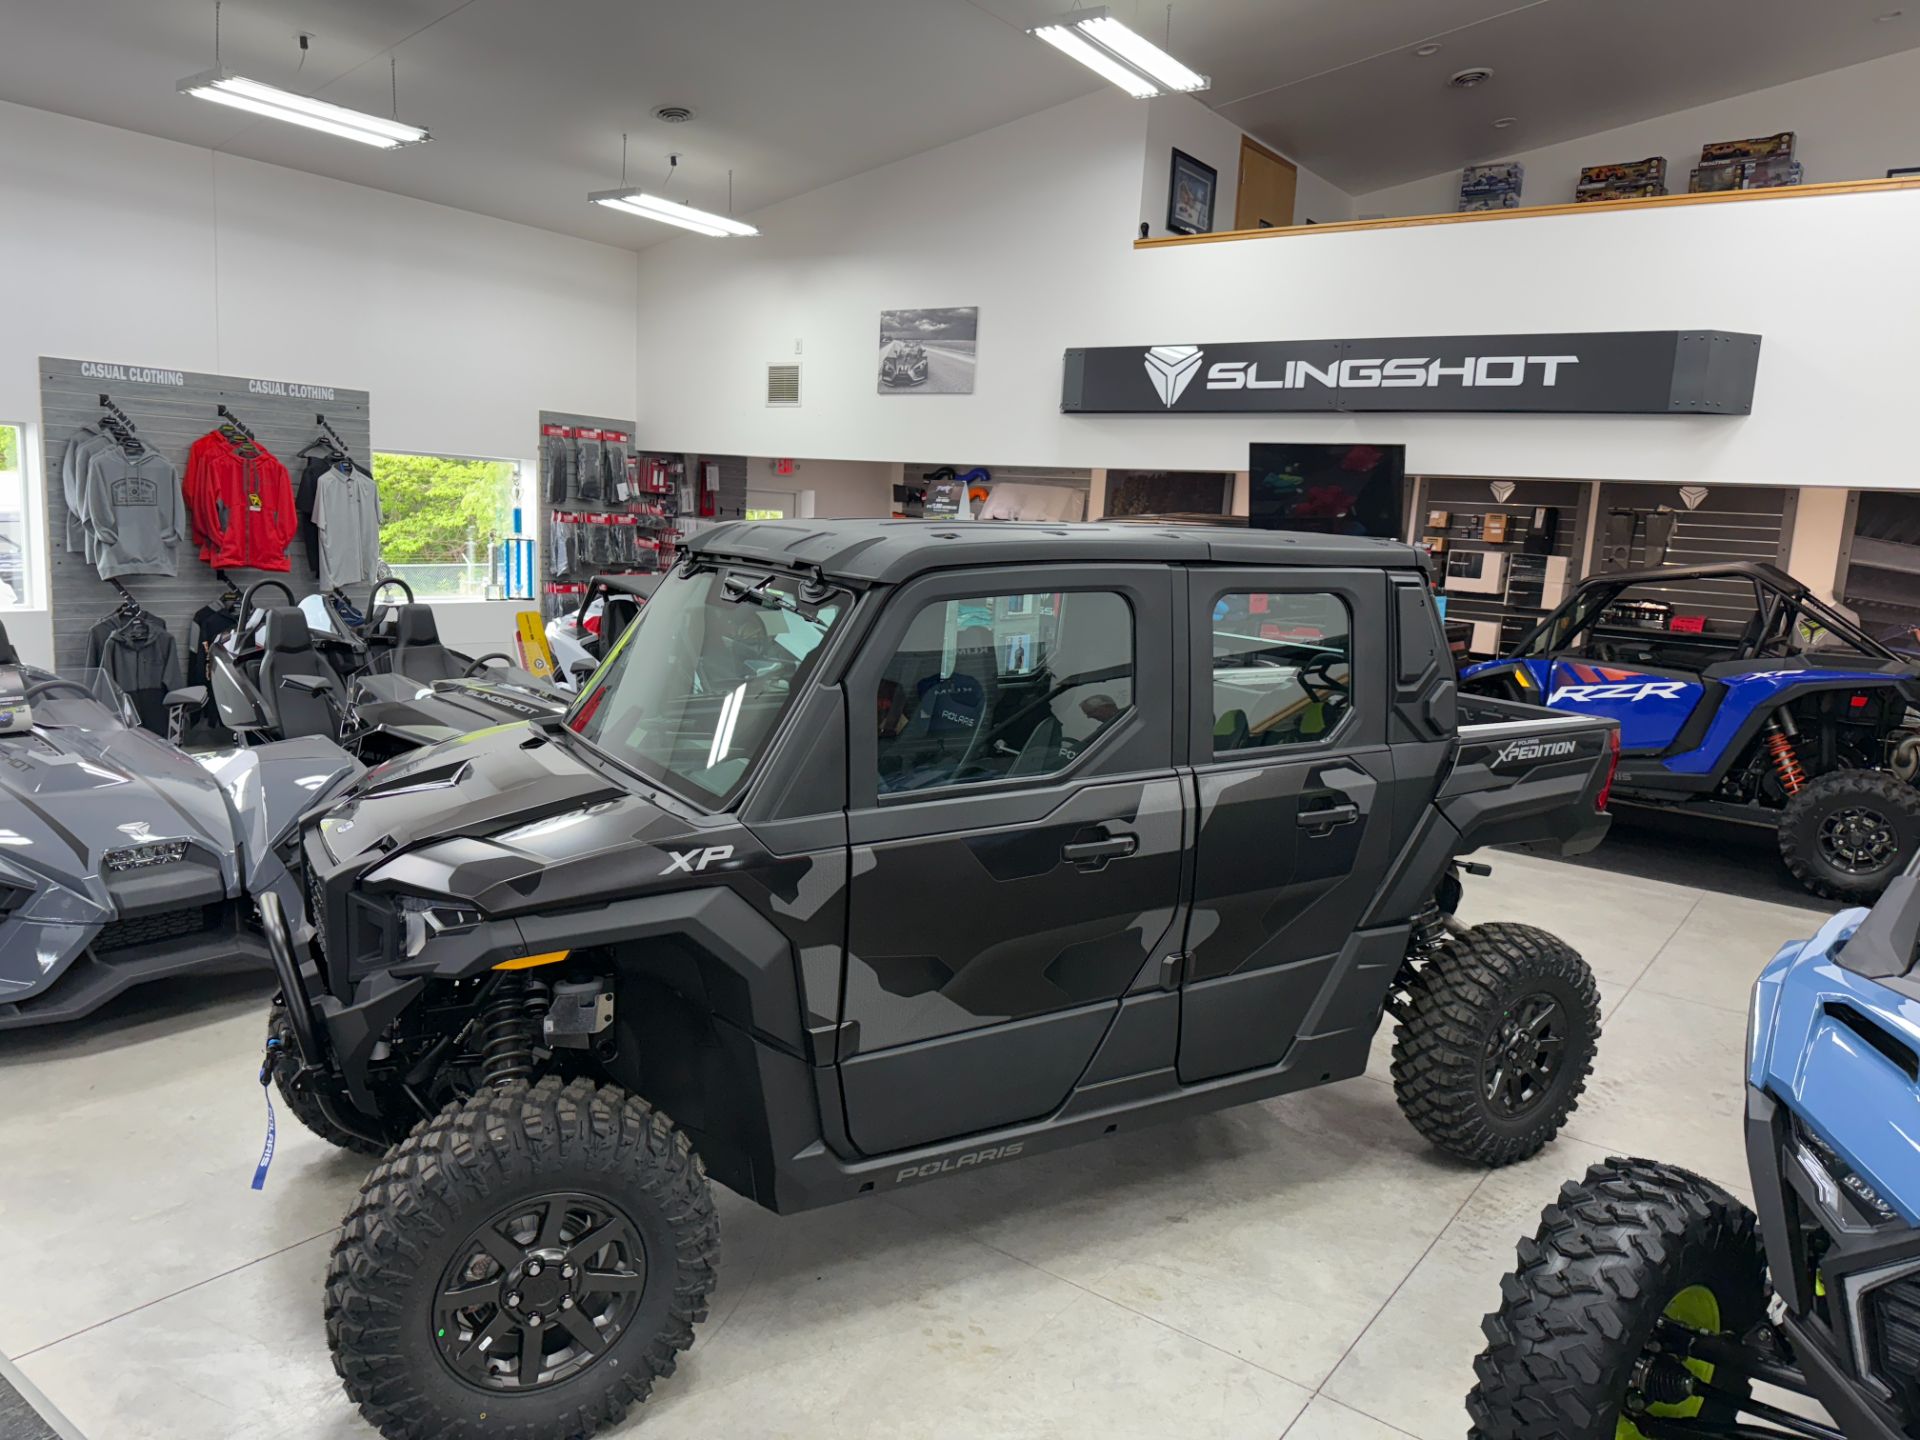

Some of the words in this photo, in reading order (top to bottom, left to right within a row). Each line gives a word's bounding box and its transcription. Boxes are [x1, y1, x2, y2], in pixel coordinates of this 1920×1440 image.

[81, 362, 127, 380] CASUAL
[129, 367, 184, 386] CLOTHING
[1206, 355, 1580, 390] SLINGSHOT
[248, 379, 287, 396] CASUAL
[288, 384, 335, 401] CLOTHING
[464, 689, 540, 715] SLINGSHOT
[1547, 681, 1688, 706] RZR
[1489, 740, 1577, 769] XPEDITION
[658, 844, 735, 876] XP
[895, 1142, 1025, 1183] POLARIS
